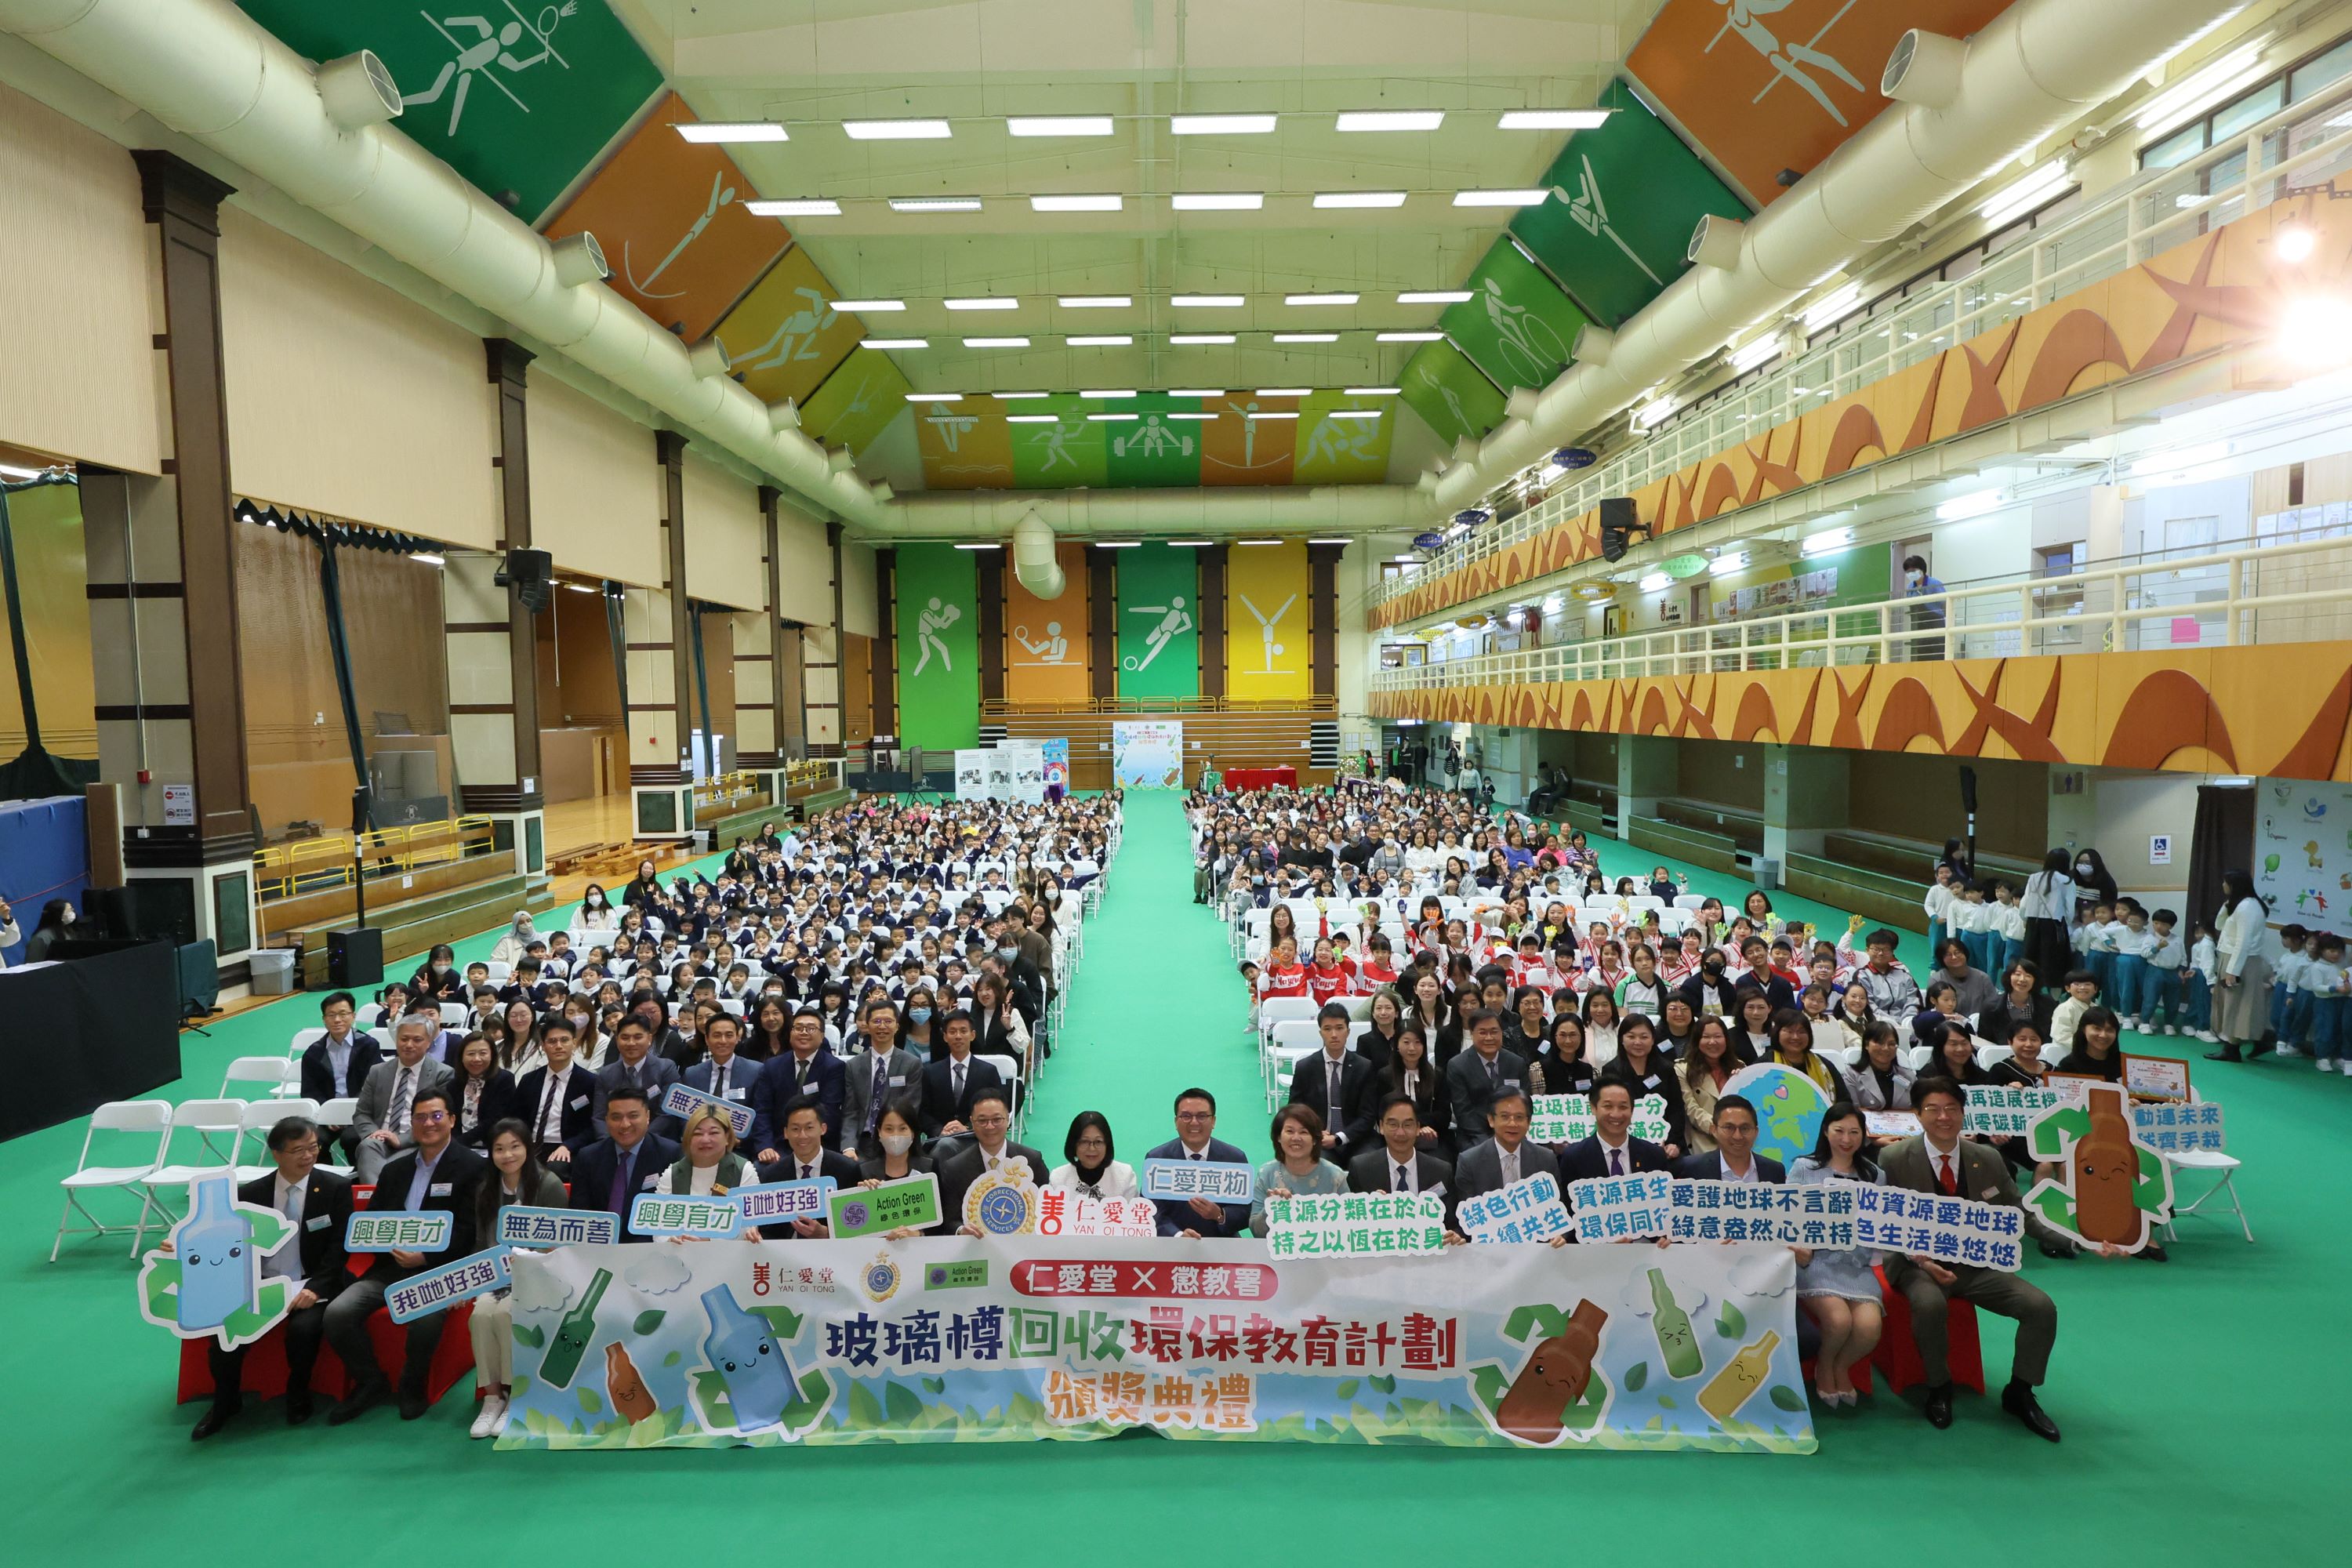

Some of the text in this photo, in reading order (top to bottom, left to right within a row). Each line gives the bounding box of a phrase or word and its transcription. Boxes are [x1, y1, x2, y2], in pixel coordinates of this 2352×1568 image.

[669, 1091, 749, 1132] 無善
[1533, 1098, 1663, 1116] 垃圾提分
[1530, 1121, 1666, 1139] 花草樹滿分
[1962, 1112, 2035, 1132] 零碳新
[1149, 1165, 1248, 1196] 仁愛齊物
[1573, 1176, 1668, 1209] 資源再生
[743, 1188, 831, 1217] 哋好強
[877, 1192, 925, 1211] Action Green
[985, 1189, 1024, 1214] CORRECTIONAL
[1076, 1200, 1152, 1225] 仁愛堂
[1270, 1196, 1441, 1224] 資源分類在於心
[1462, 1178, 1555, 1229] 綠色行動
[1671, 1185, 1853, 1214] 愛護地球不言辭
[505, 1214, 612, 1244] 無為而善
[636, 1201, 738, 1230] 興學育才
[985, 1217, 1014, 1232] SERVICES
[351, 1219, 445, 1243] 興學育才
[1073, 1225, 1152, 1237] YAN OI TONG
[1272, 1226, 1443, 1254] 持之以恆在於身
[1671, 1215, 1853, 1245] 綠意盎然心常持
[779, 1267, 834, 1283] 仁愛堂
[968, 1265, 982, 1274] Green
[1026, 1264, 1116, 1295] 仁愛堂
[1171, 1265, 1261, 1296] 懲教署
[826, 1305, 1456, 1370] 玻璃樽回收環保教育計劃
[1051, 1370, 1251, 1430] 頒獎典禮
